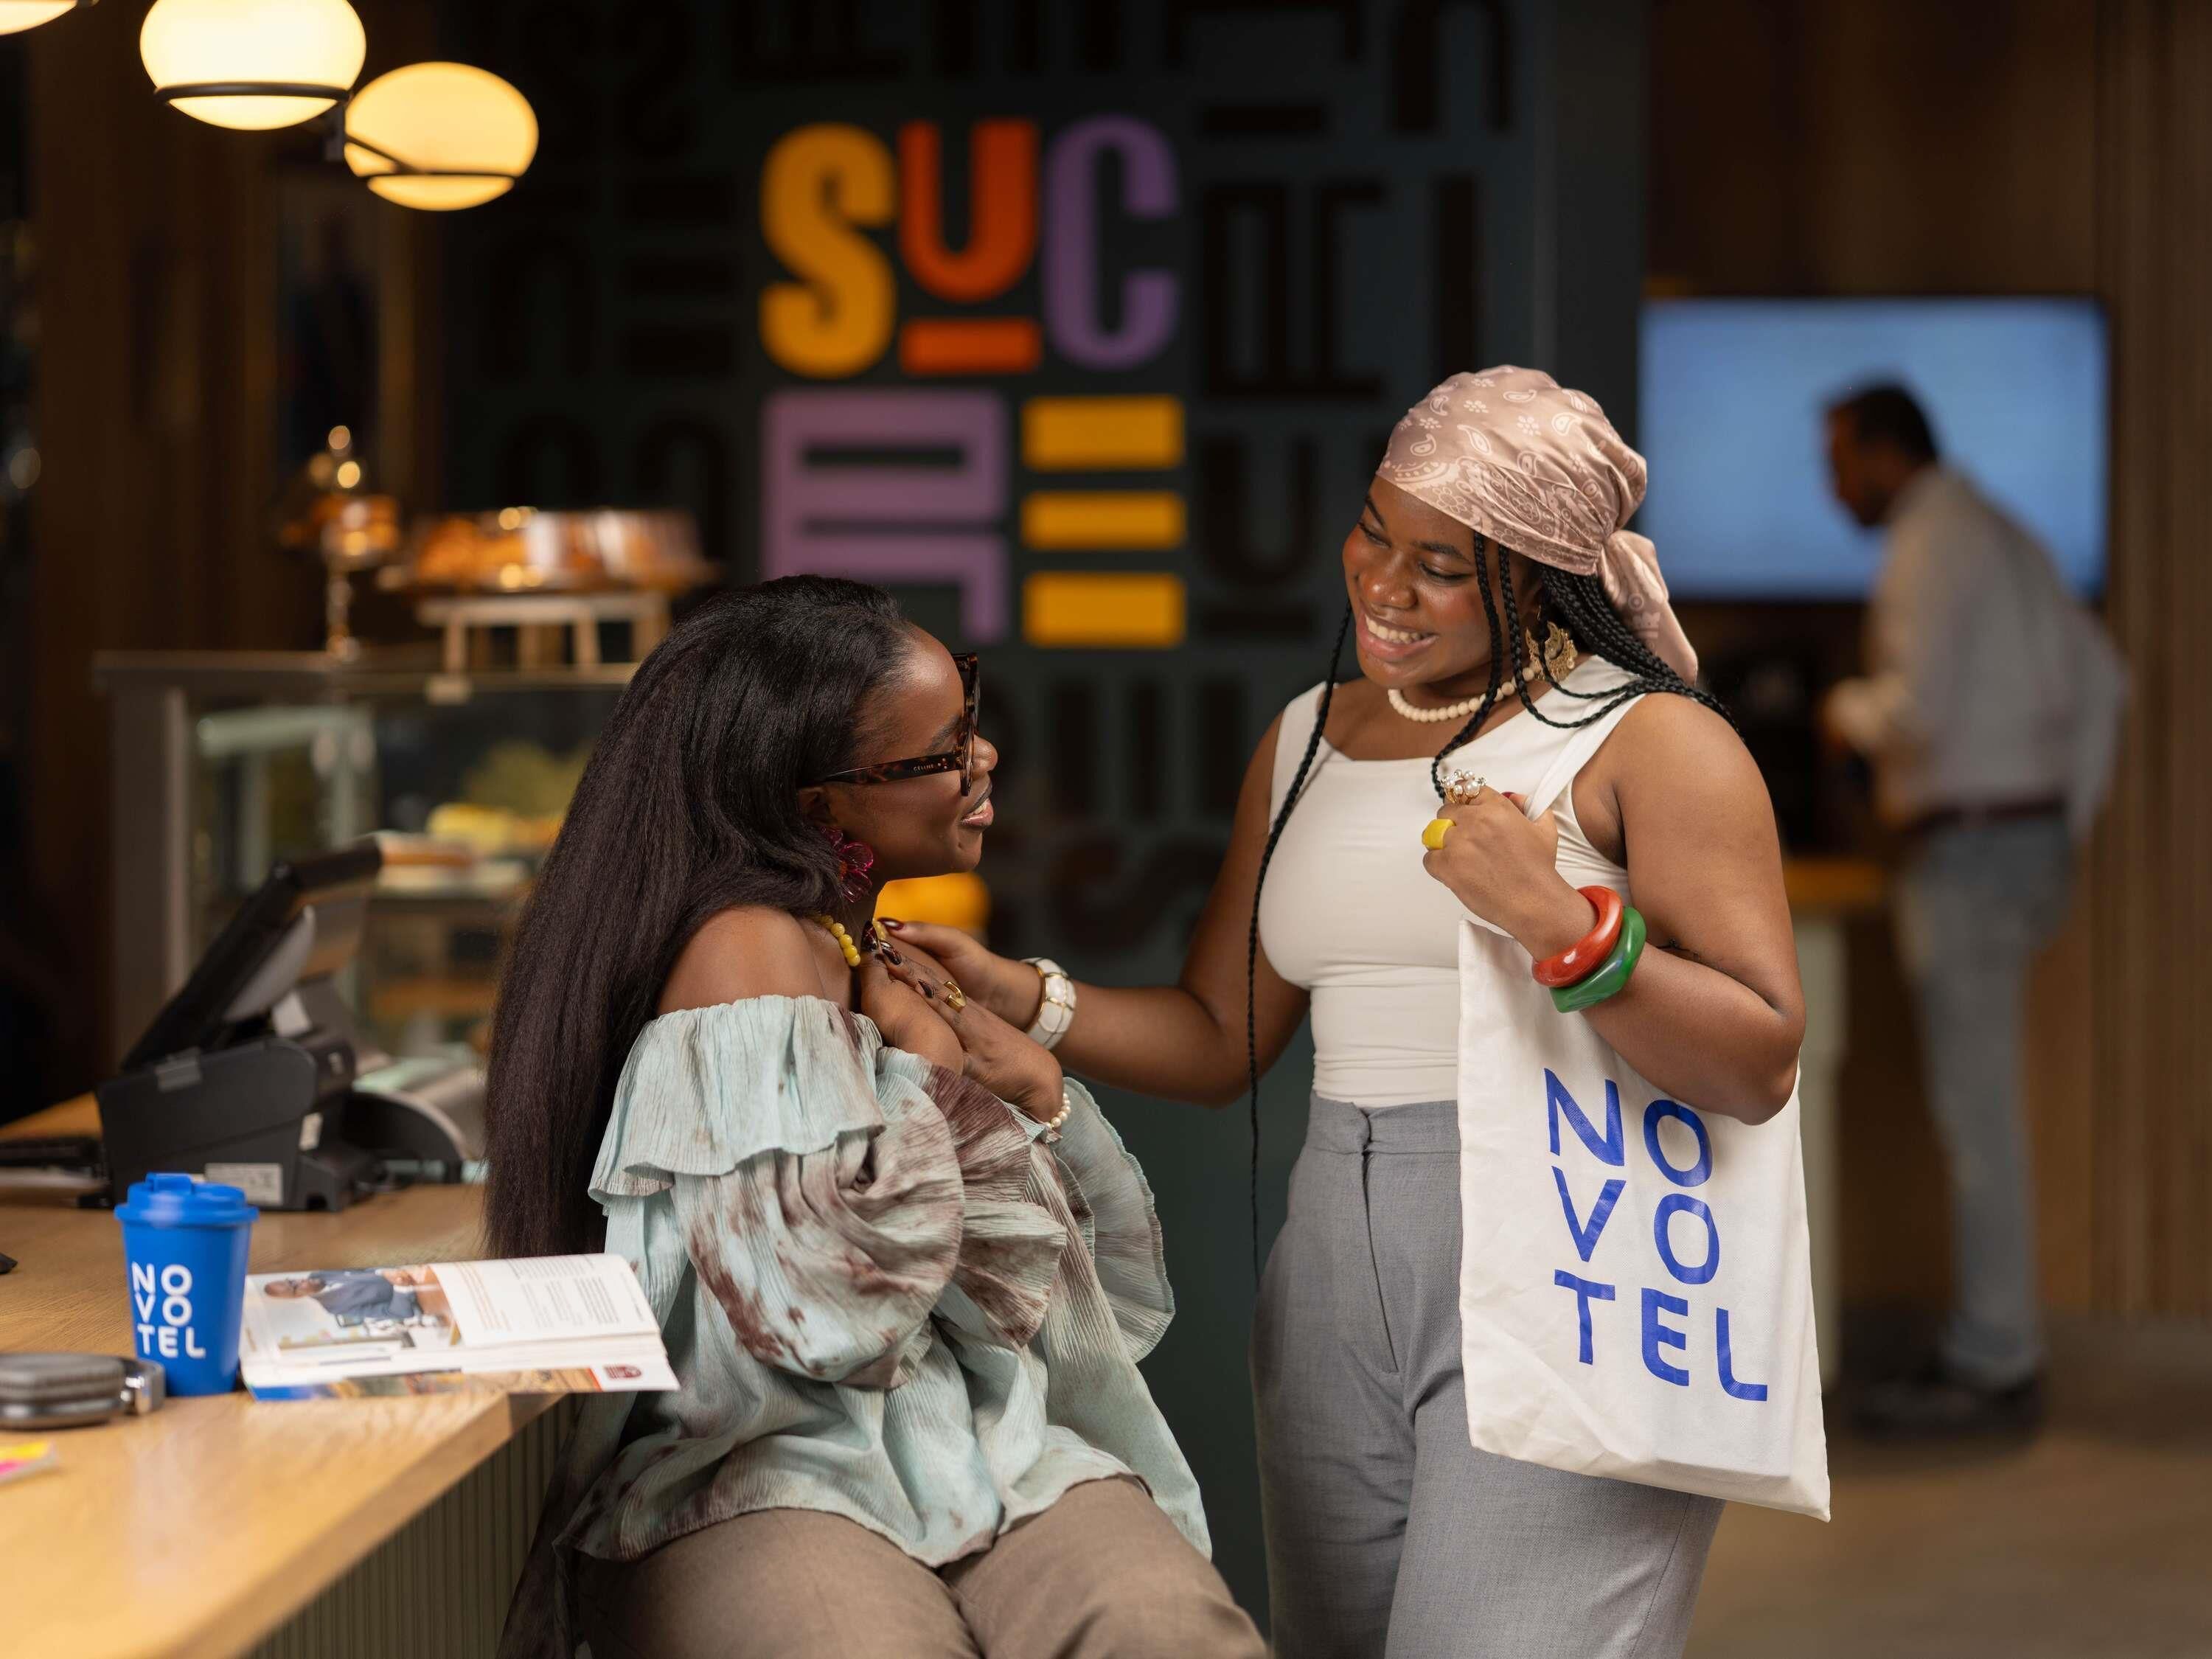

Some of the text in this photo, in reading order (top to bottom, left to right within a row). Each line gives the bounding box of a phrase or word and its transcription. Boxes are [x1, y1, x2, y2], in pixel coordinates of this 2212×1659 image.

[759, 116, 1177, 378] SUC
[1544, 1068, 1713, 1187] NO
[131, 1261, 192, 1295] NO
[1551, 1166, 1719, 1284] VO
[134, 1293, 192, 1326] VO
[137, 1323, 206, 1358] TEL
[1554, 1269, 1767, 1401] TEL
